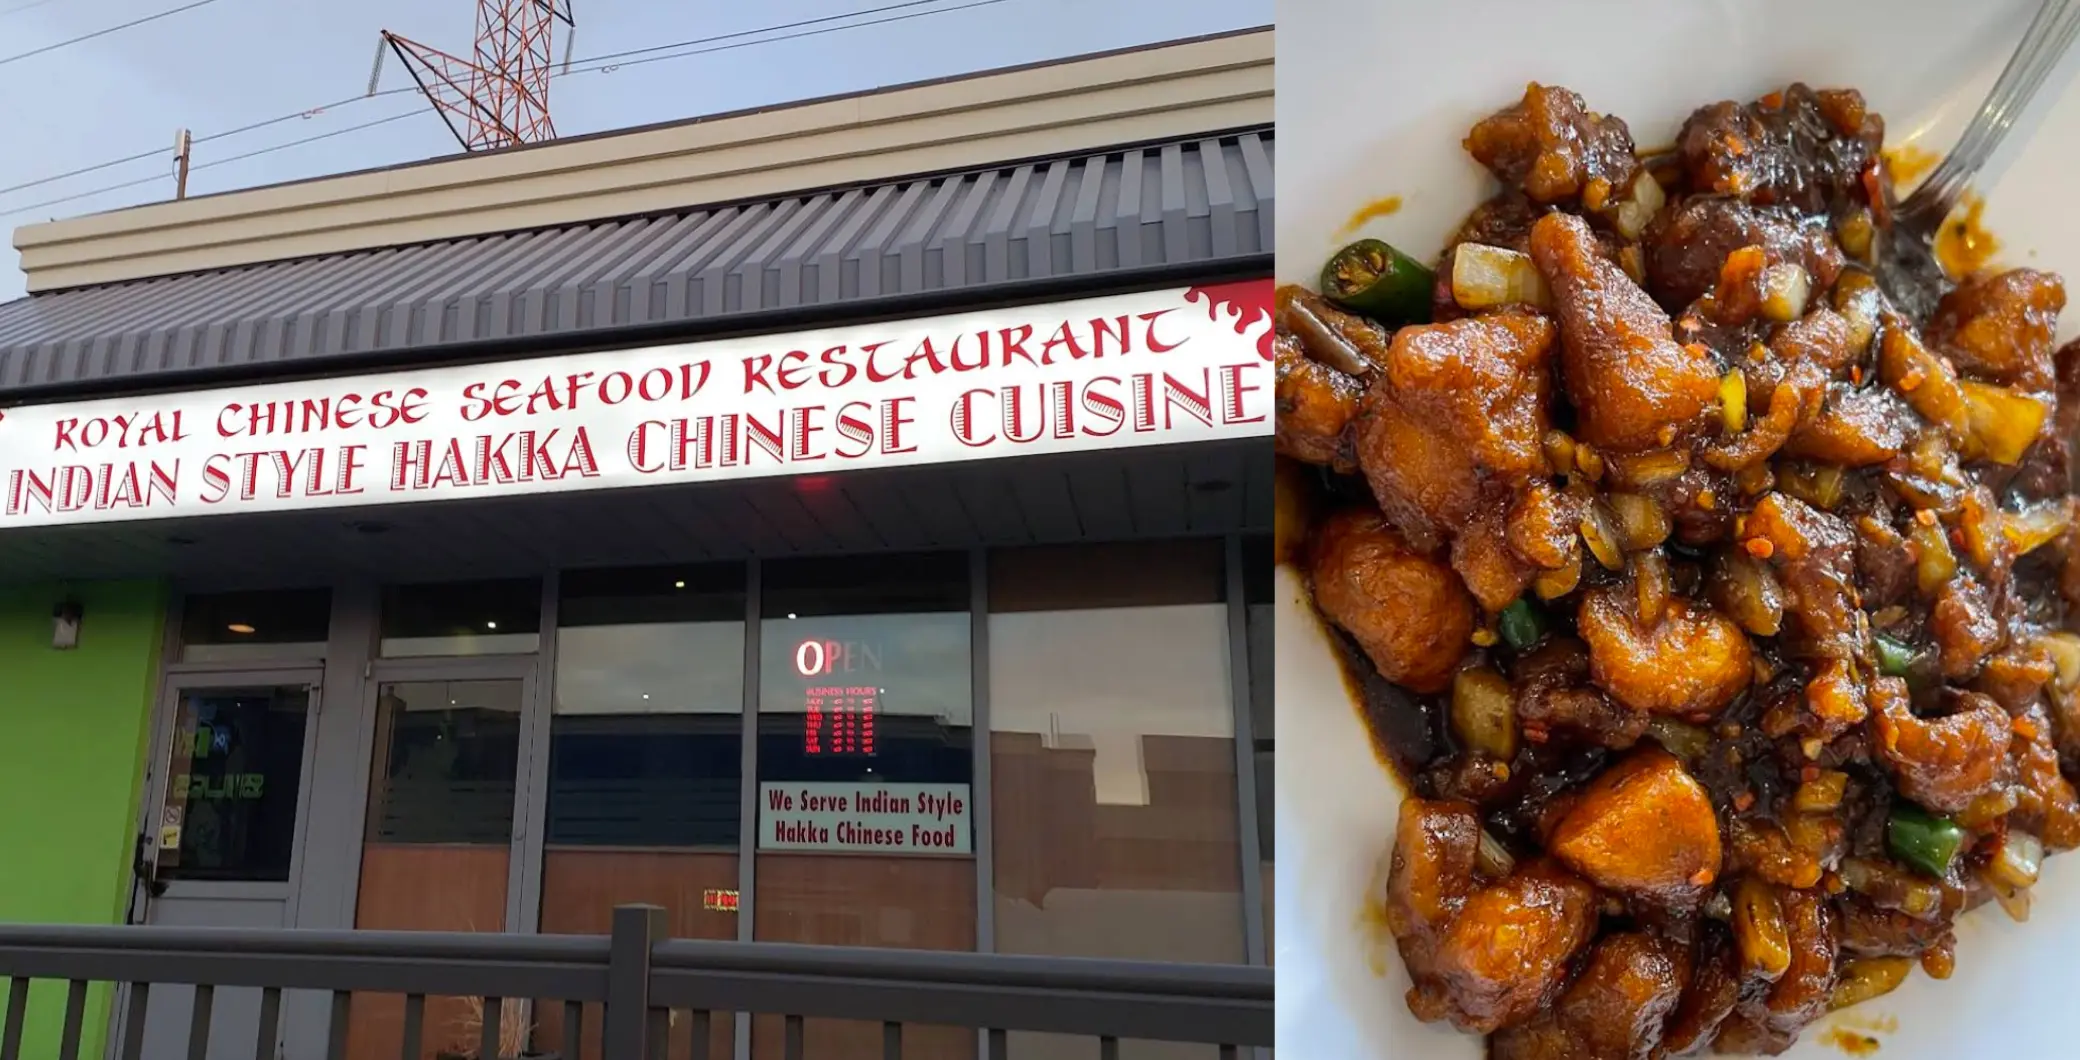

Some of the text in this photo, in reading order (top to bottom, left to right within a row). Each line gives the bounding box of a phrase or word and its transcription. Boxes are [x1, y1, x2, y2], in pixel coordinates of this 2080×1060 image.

[55, 307, 1190, 451] ROYAL CHINESE SEAFOOD RESTAURANT
[6, 360, 1267, 516] INDIAN STYLE HAKKA CHINESE CUISINE
[796, 640, 883, 676] OPEN
[806, 687, 877, 696] BUSINESS HOURS
[769, 789, 963, 821] We Serve Indian Style
[775, 820, 955, 847] Hakka Chinese Food
